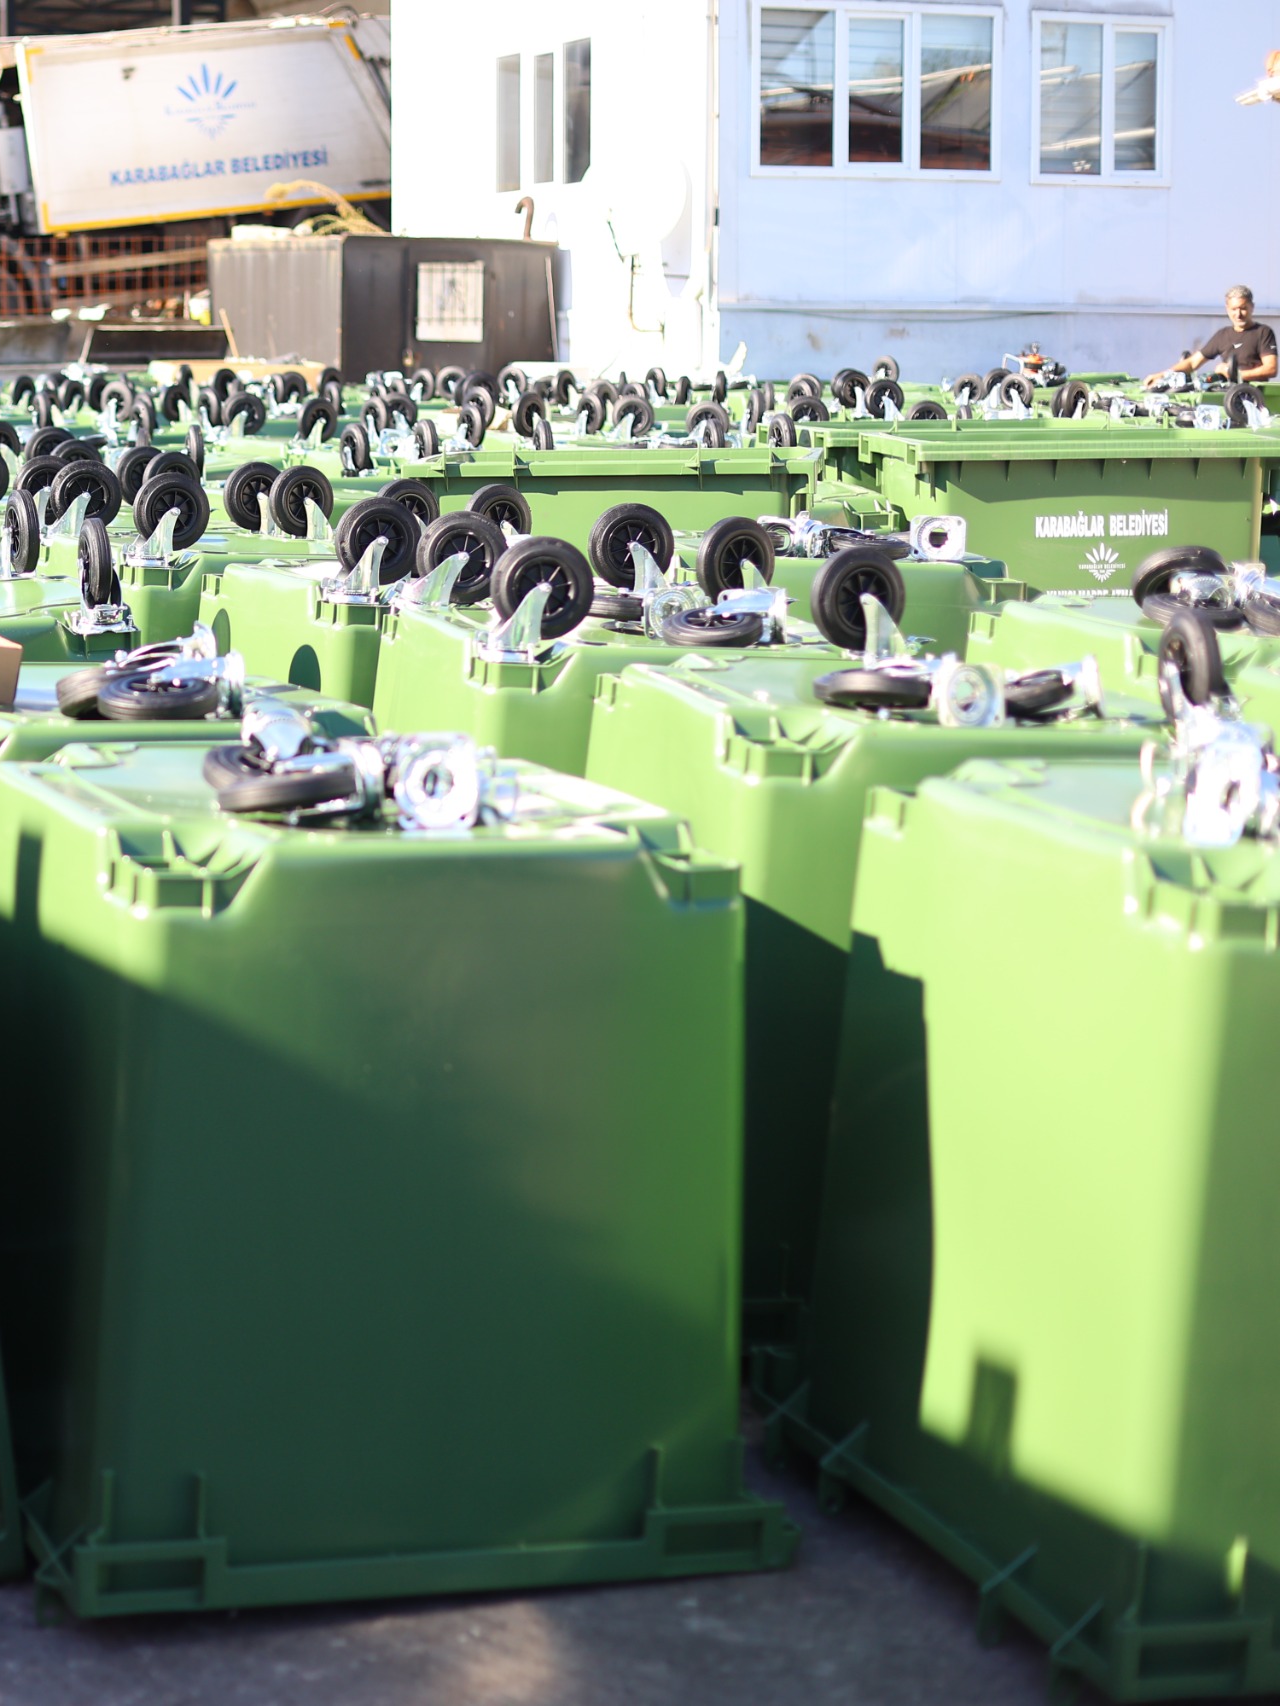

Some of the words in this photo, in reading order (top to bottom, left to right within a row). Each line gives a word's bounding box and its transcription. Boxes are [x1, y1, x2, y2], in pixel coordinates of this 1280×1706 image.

[110, 159, 225, 186] KARABAĞLAR
[231, 145, 329, 174] BELEDİYESİ
[1035, 511, 1105, 538] KARABAĞLAR
[1109, 509, 1168, 536] BELEDİYESİ
